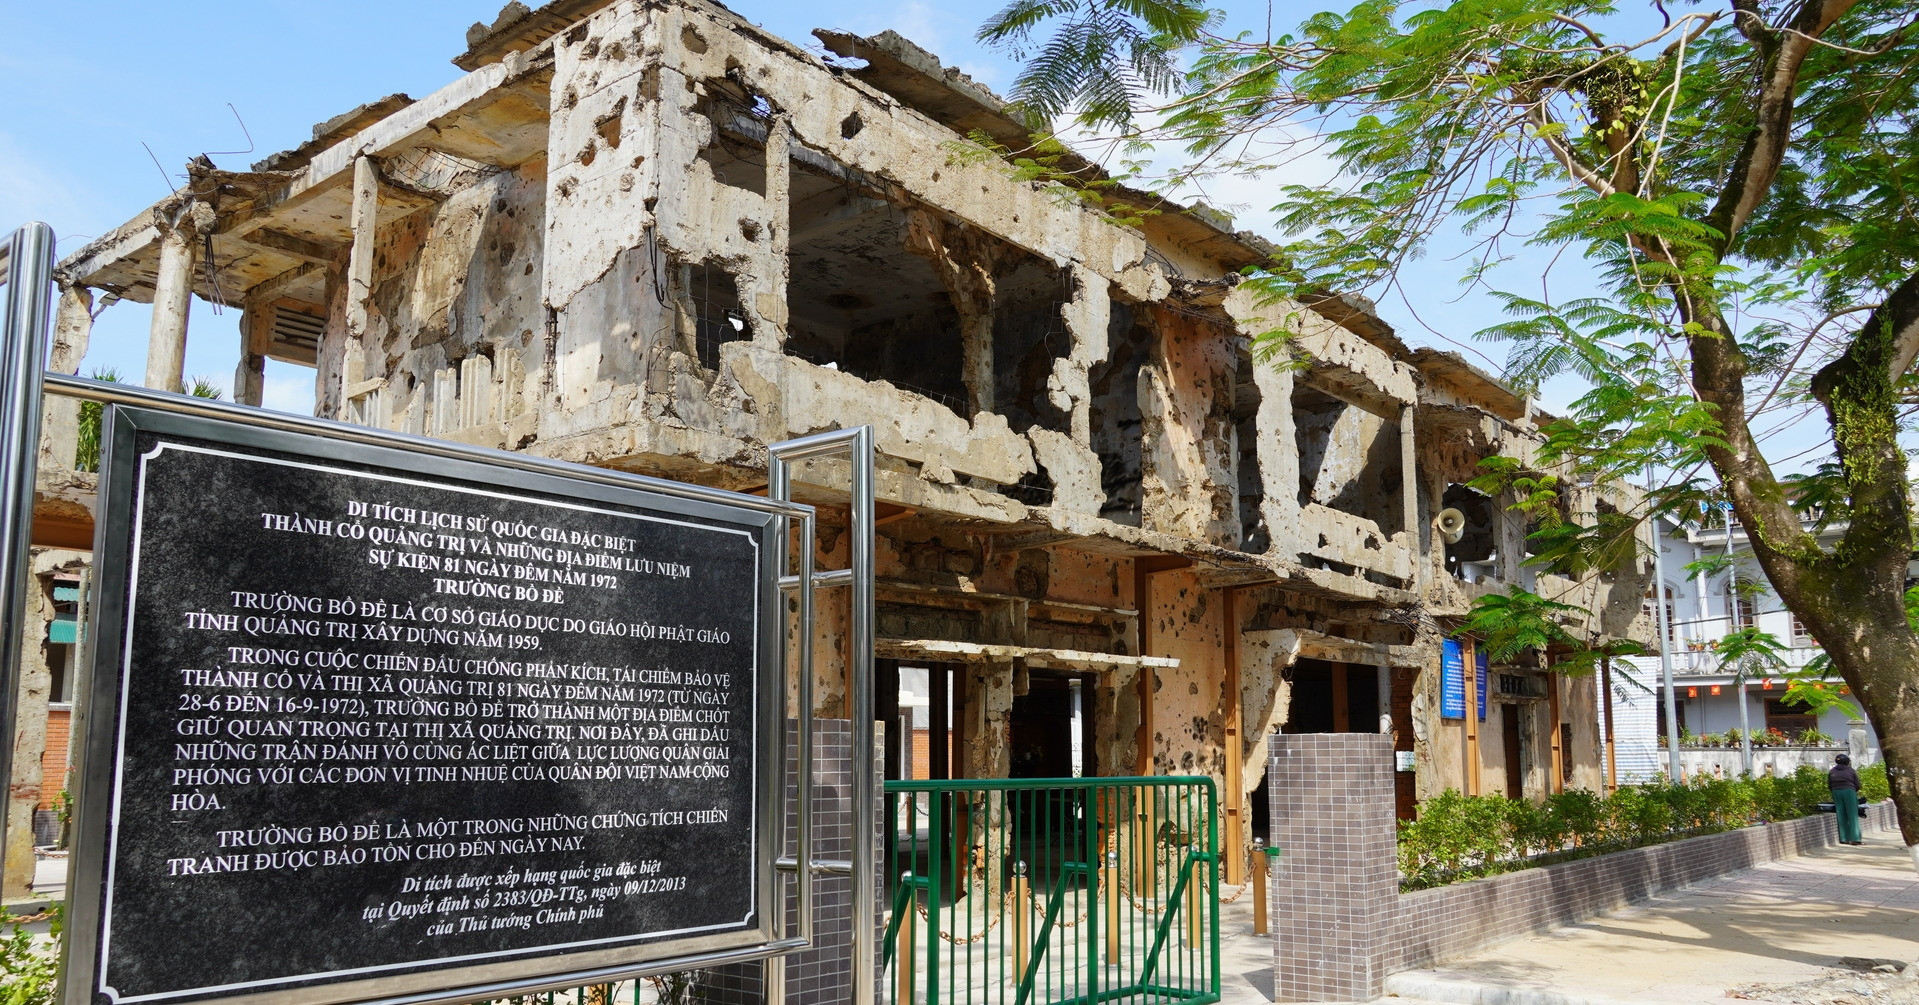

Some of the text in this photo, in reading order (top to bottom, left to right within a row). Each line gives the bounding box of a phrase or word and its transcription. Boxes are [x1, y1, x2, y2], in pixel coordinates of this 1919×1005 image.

[261, 513, 691, 580] THÀNH CỔ QUẢNG TRỊ VÀ NHỮNG ĐỊA ĐIỂM LƯU NIỆM
[346, 501, 636, 554] DI TÍCH LỊCH SỬ QUỐC GIA ĐẶC BIỆT
[368, 551, 617, 589] SỰ KIỆN 81 NGÀY ĐÊM NĂM 1972
[432, 578, 564, 604] TRƯỜNG BỒ ĐỀ
[184, 609, 543, 650] TỈNH QUẢNG TRỊ XÂY DỰNG NĂM 1959.
[230, 591, 730, 644] TRƯỜNG BỒ ĐỀ LÀ CƠ SỞ GIÁO DỤC DO GIÁO HỘI PHẬT GIÁO
[180, 666, 730, 706] THÀNH CỔ VÀ THỊ XÃ QUẢNG TRỊ 81 NGÀY ĐÊM NĂM 1972 (TỪ NGÀY
[227, 647, 300, 666] TRONG
[303, 648, 359, 673] CUỘC
[362, 651, 418, 672] CHIẾN
[422, 653, 460, 674] ĐẤU
[463, 656, 522, 677] CHỐNG
[524, 660, 567, 679] PHẢN
[570, 662, 610, 685] KÍCH,
[612, 665, 636, 683] TÁI
[683, 669, 711, 687] BẢO
[713, 670, 730, 691] VỆ
[177, 691, 730, 724] 28-6 ĐẾN 16-9-1972), TRƯỜNG BỒ ĐỀ TRỞ THÀNH MỘT ĐỊA ĐIỂM CHỐT
[176, 716, 729, 744] GIỮ QUAN TRỌNG TẠI THỊ XÃ QUẢNG TRỊ. NƠI ĐÂY, ĐÃ GHI DẤU
[174, 739, 729, 765] NHỮNG TRẬN ĐÁNH VÔ CÙNG ÁC LIỆT GIỮA LỰC LƯỢNG QUÂN GIẢI
[171, 764, 251, 785] PHÓNG
[256, 763, 294, 784] VỚI
[298, 763, 341, 784] CÁC
[344, 767, 386, 783] ĐƠN
[391, 767, 411, 787] VỊ
[414, 767, 457, 782] TINH
[461, 763, 508, 786] NHUỆ
[511, 763, 545, 781] CỦA
[548, 762, 592, 784] QUÂN
[595, 762, 621, 784] ĐỘI
[623, 762, 656, 783] VIỆT
[170, 788, 226, 810] HÒA.
[216, 807, 728, 848] TRƯỜNG BỒ ĐỀ LÀ MỘT TRONG NHỮNG CHỨNG TÍCH CHIẾN
[166, 835, 585, 876] TRANH ĐƯỢC BẢO TỒN CHO ĐẾN NGÀY NAY.
[400, 862, 661, 893] Di tích được xếp hạng quốc gia đặc biệt
[361, 878, 686, 923] tại Quyết định số 2383/QĐ-TTg, ngày 09/12/2013
[425, 903, 604, 936] của Thủ tướng Chính phủ
